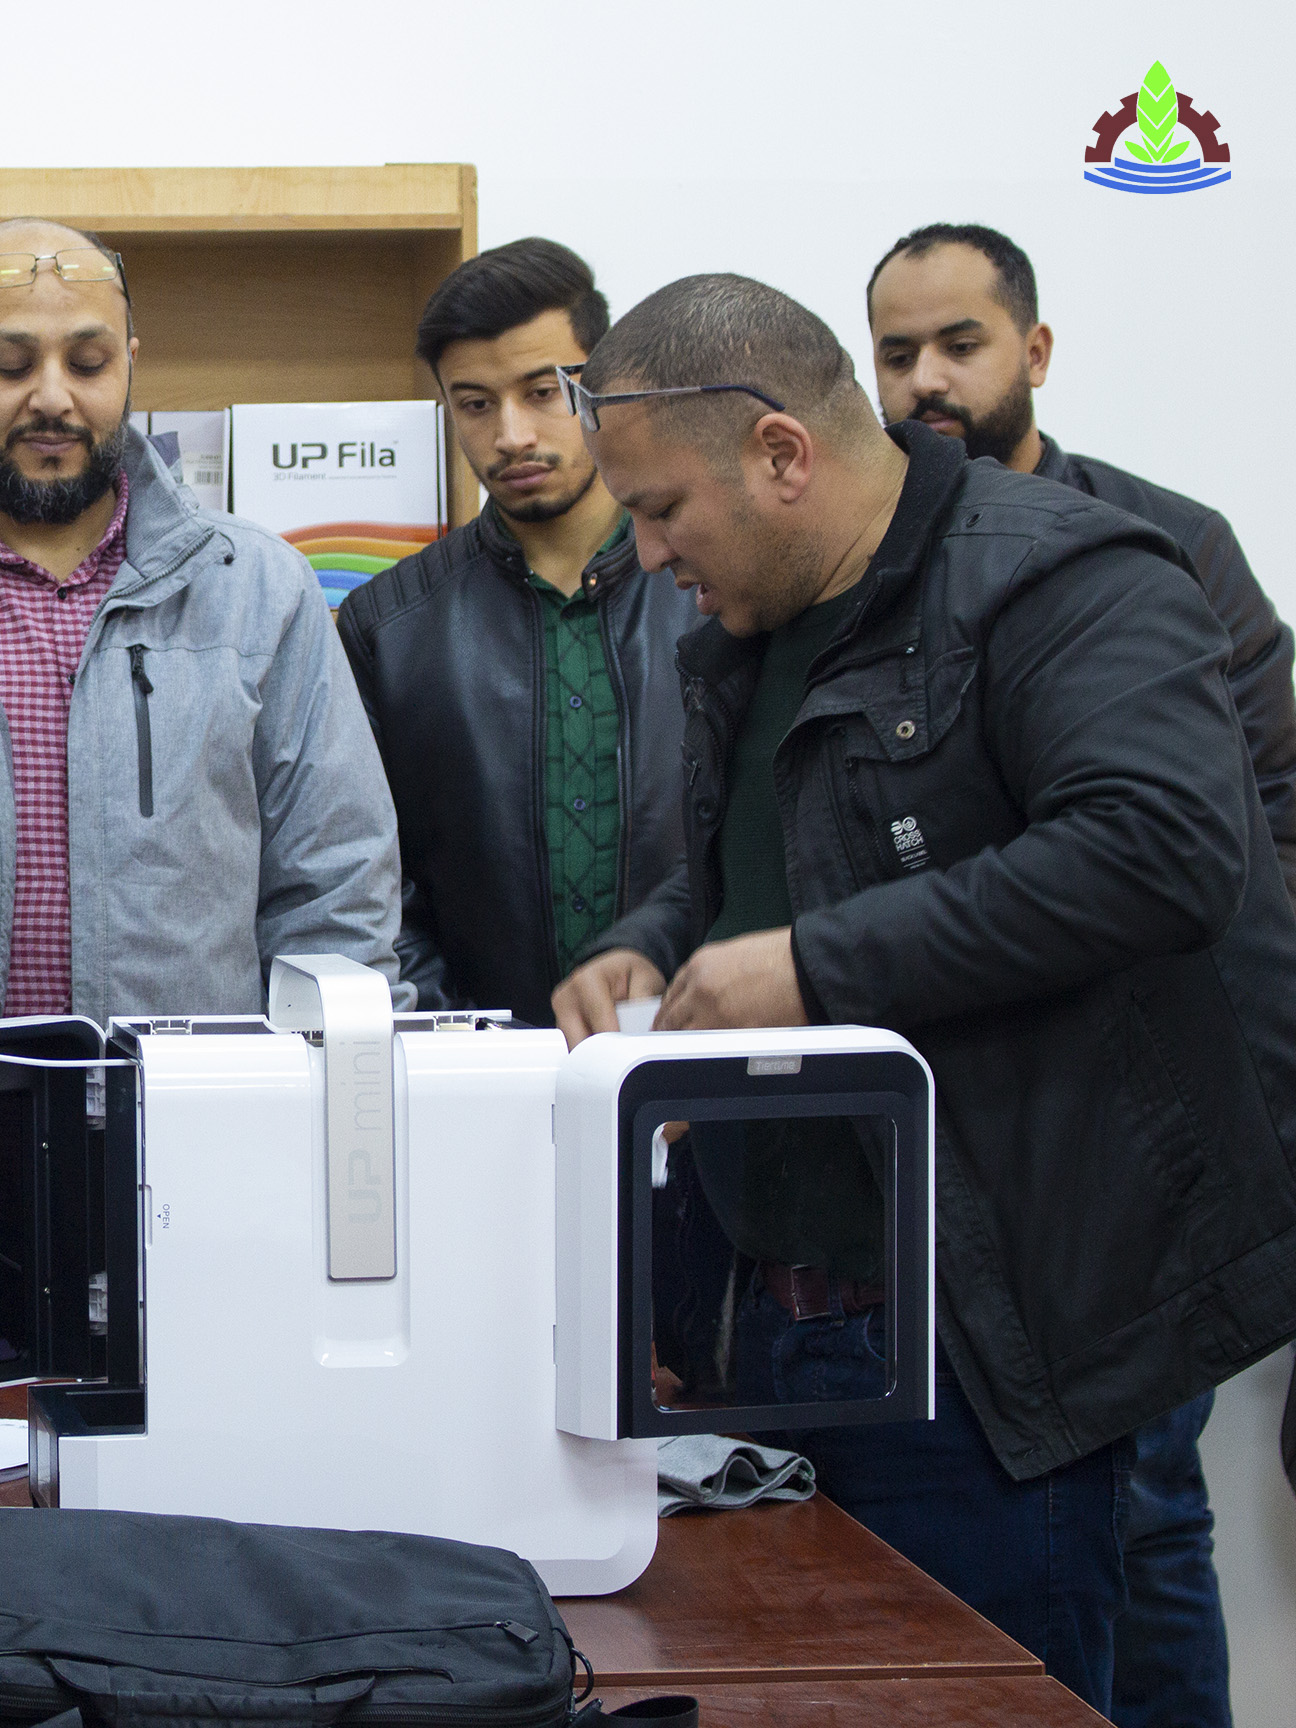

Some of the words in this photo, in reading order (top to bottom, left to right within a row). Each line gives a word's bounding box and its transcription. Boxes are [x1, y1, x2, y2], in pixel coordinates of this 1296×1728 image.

[272, 443, 329, 469] UP
[337, 441, 396, 468] Fila
[273, 472, 286, 481] 3D
[288, 472, 327, 481] Filament
[894, 829, 922, 845] CROSS
[895, 836, 924, 852] HATCH
[339, 1041, 381, 1131] mini
[347, 1149, 382, 1224] UP
[162, 1203, 171, 1229] OPEN
